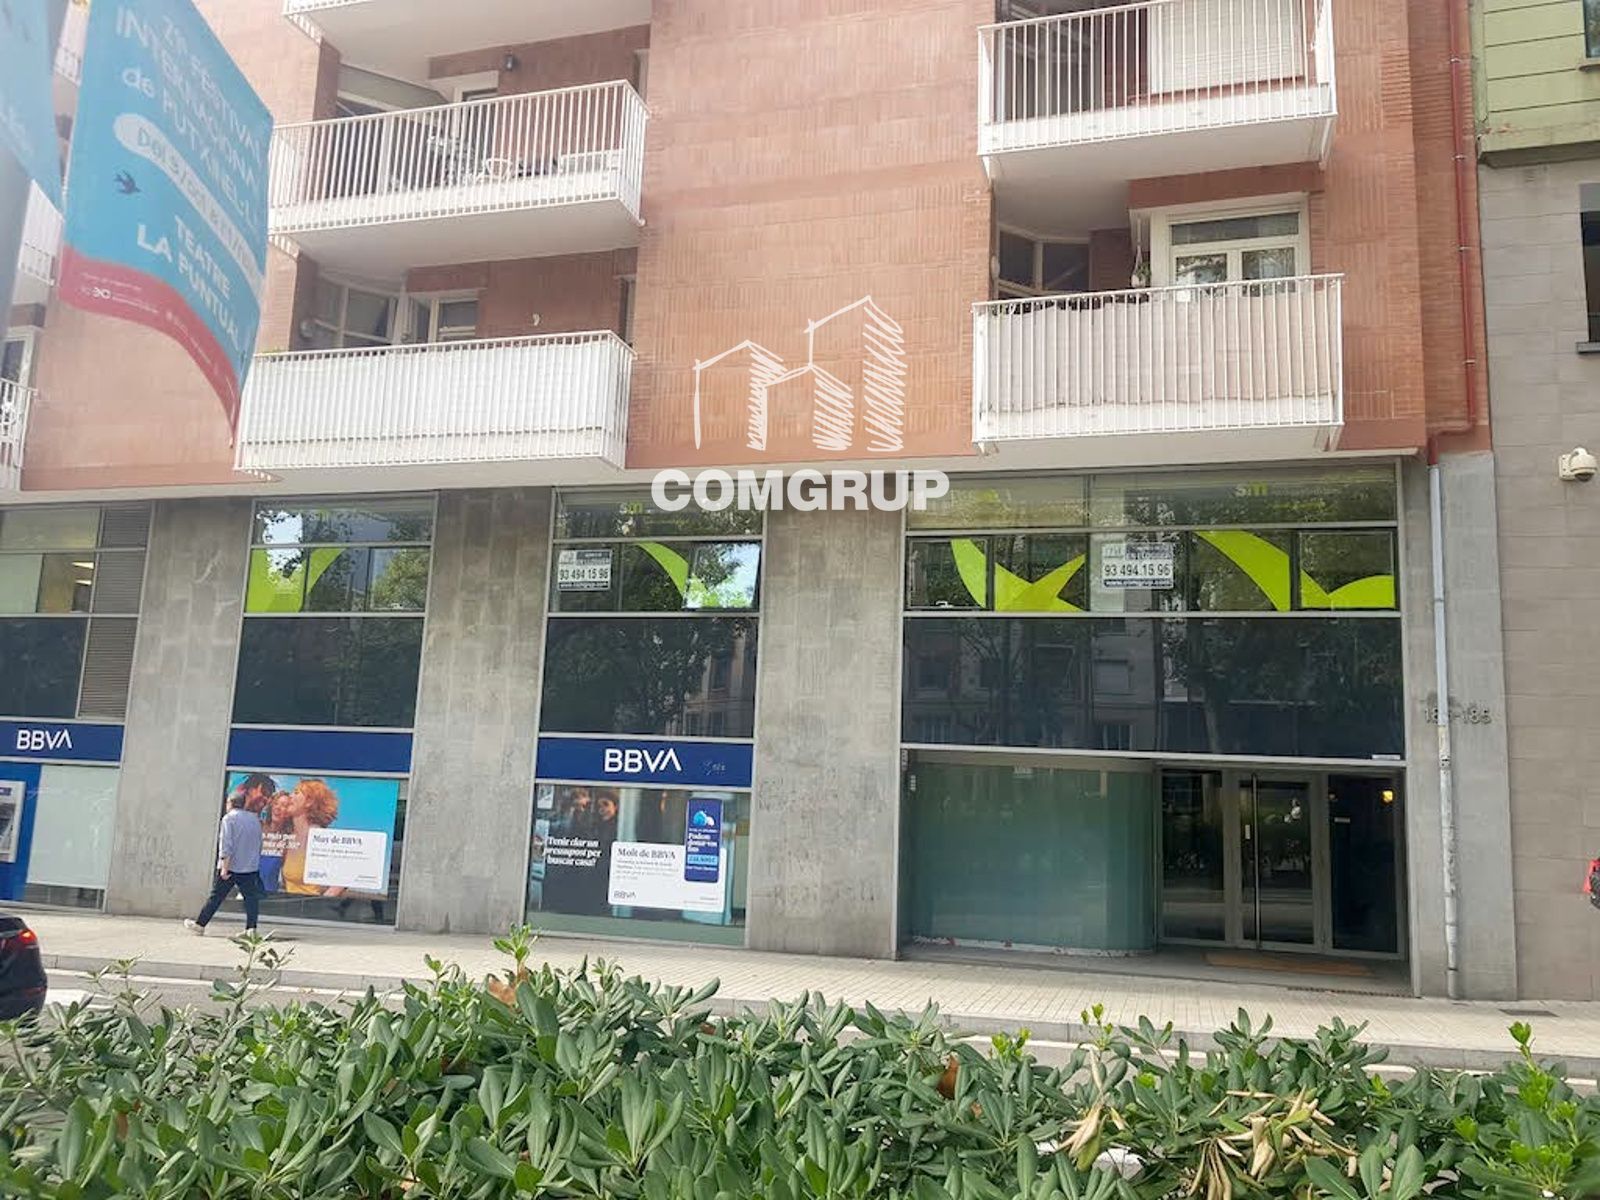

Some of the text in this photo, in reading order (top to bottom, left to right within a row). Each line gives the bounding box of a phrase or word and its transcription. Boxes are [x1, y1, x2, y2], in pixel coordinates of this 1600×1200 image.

[137, 223, 173, 263] LA
[174, 214, 231, 300] TEATRE
[1104, 564, 1117, 576] 93
[1120, 564, 1139, 576] 494
[16, 729, 73, 750] BBVA
[604, 748, 682, 773] BBVA
[331, 835, 341, 844] de
[617, 847, 638, 858] Molt
[638, 848, 650, 858] de
[650, 849, 676, 860] BBVA
